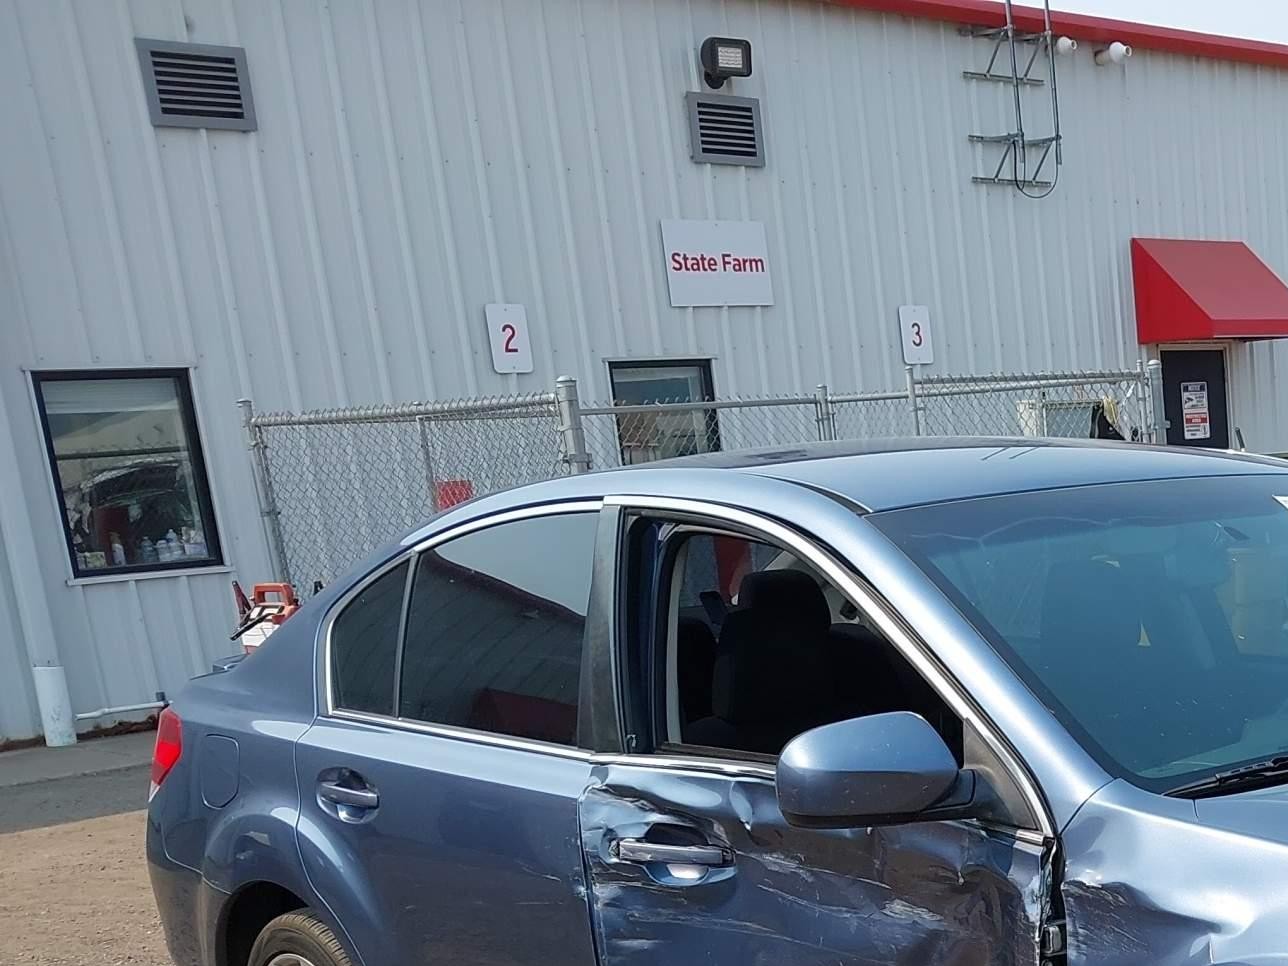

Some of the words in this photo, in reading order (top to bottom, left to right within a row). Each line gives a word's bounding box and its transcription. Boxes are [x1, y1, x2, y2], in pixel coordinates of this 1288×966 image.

[671, 252, 717, 272] State
[721, 253, 765, 273] Farm
[501, 324, 518, 352] 2
[911, 322, 922, 347] 3
